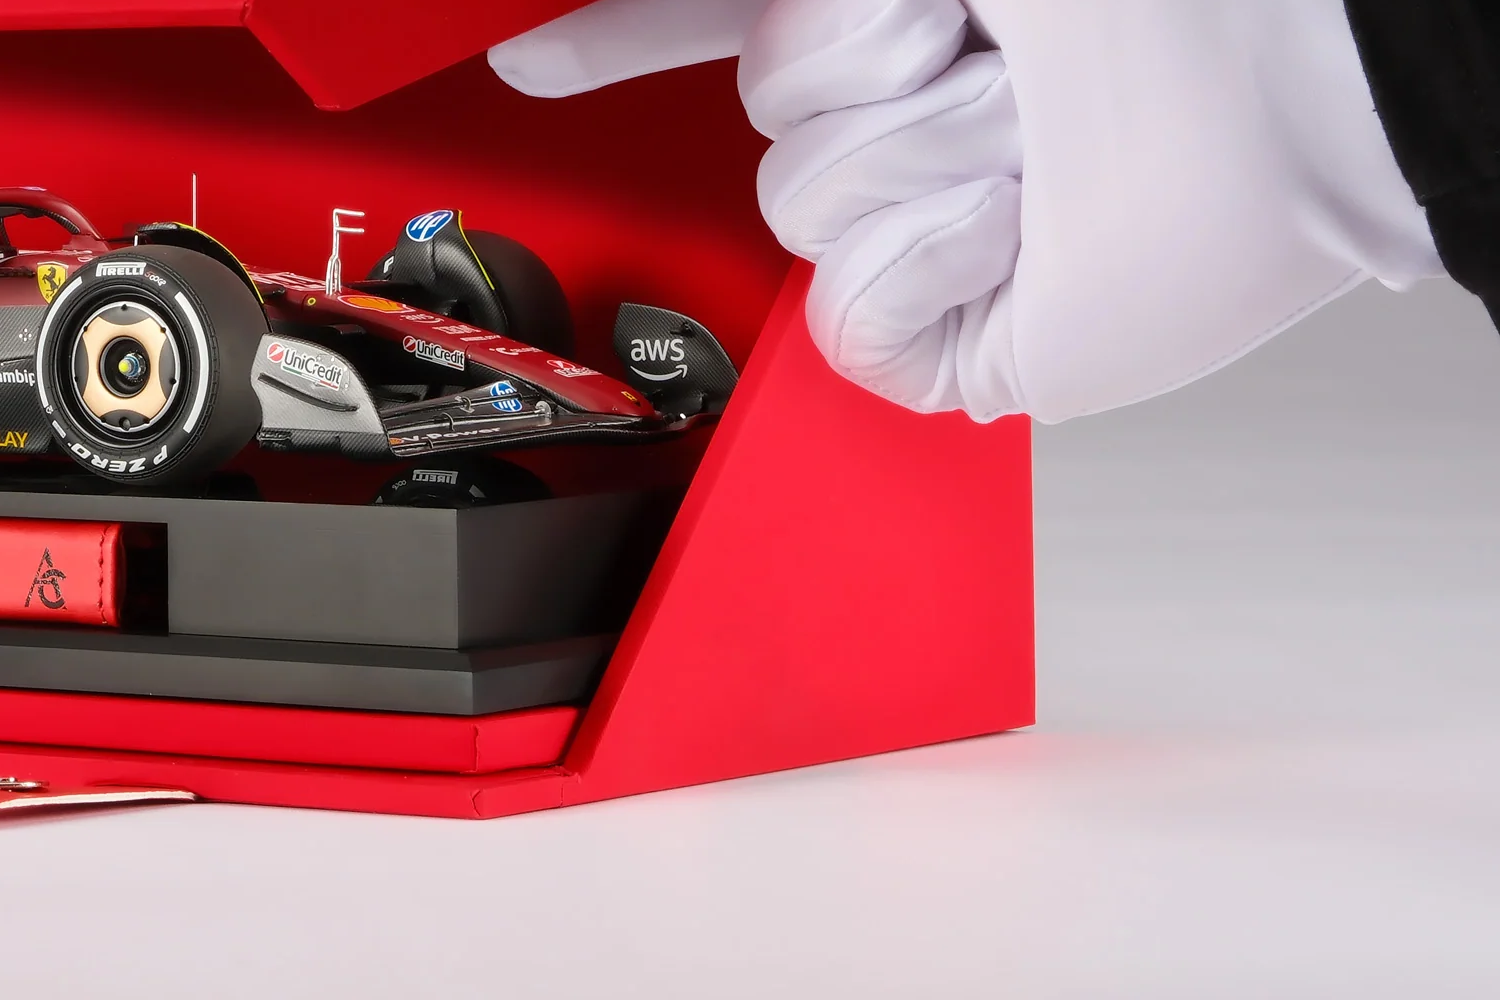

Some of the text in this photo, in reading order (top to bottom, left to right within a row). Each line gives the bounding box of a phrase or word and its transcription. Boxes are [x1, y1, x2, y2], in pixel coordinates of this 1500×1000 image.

[408, 211, 451, 241] hp
[96, 262, 146, 277] PIRELLI
[417, 340, 464, 365] UniCredit
[630, 338, 685, 362] aws
[284, 349, 341, 384] UniCredit
[70, 442, 168, 473] P ZERO
